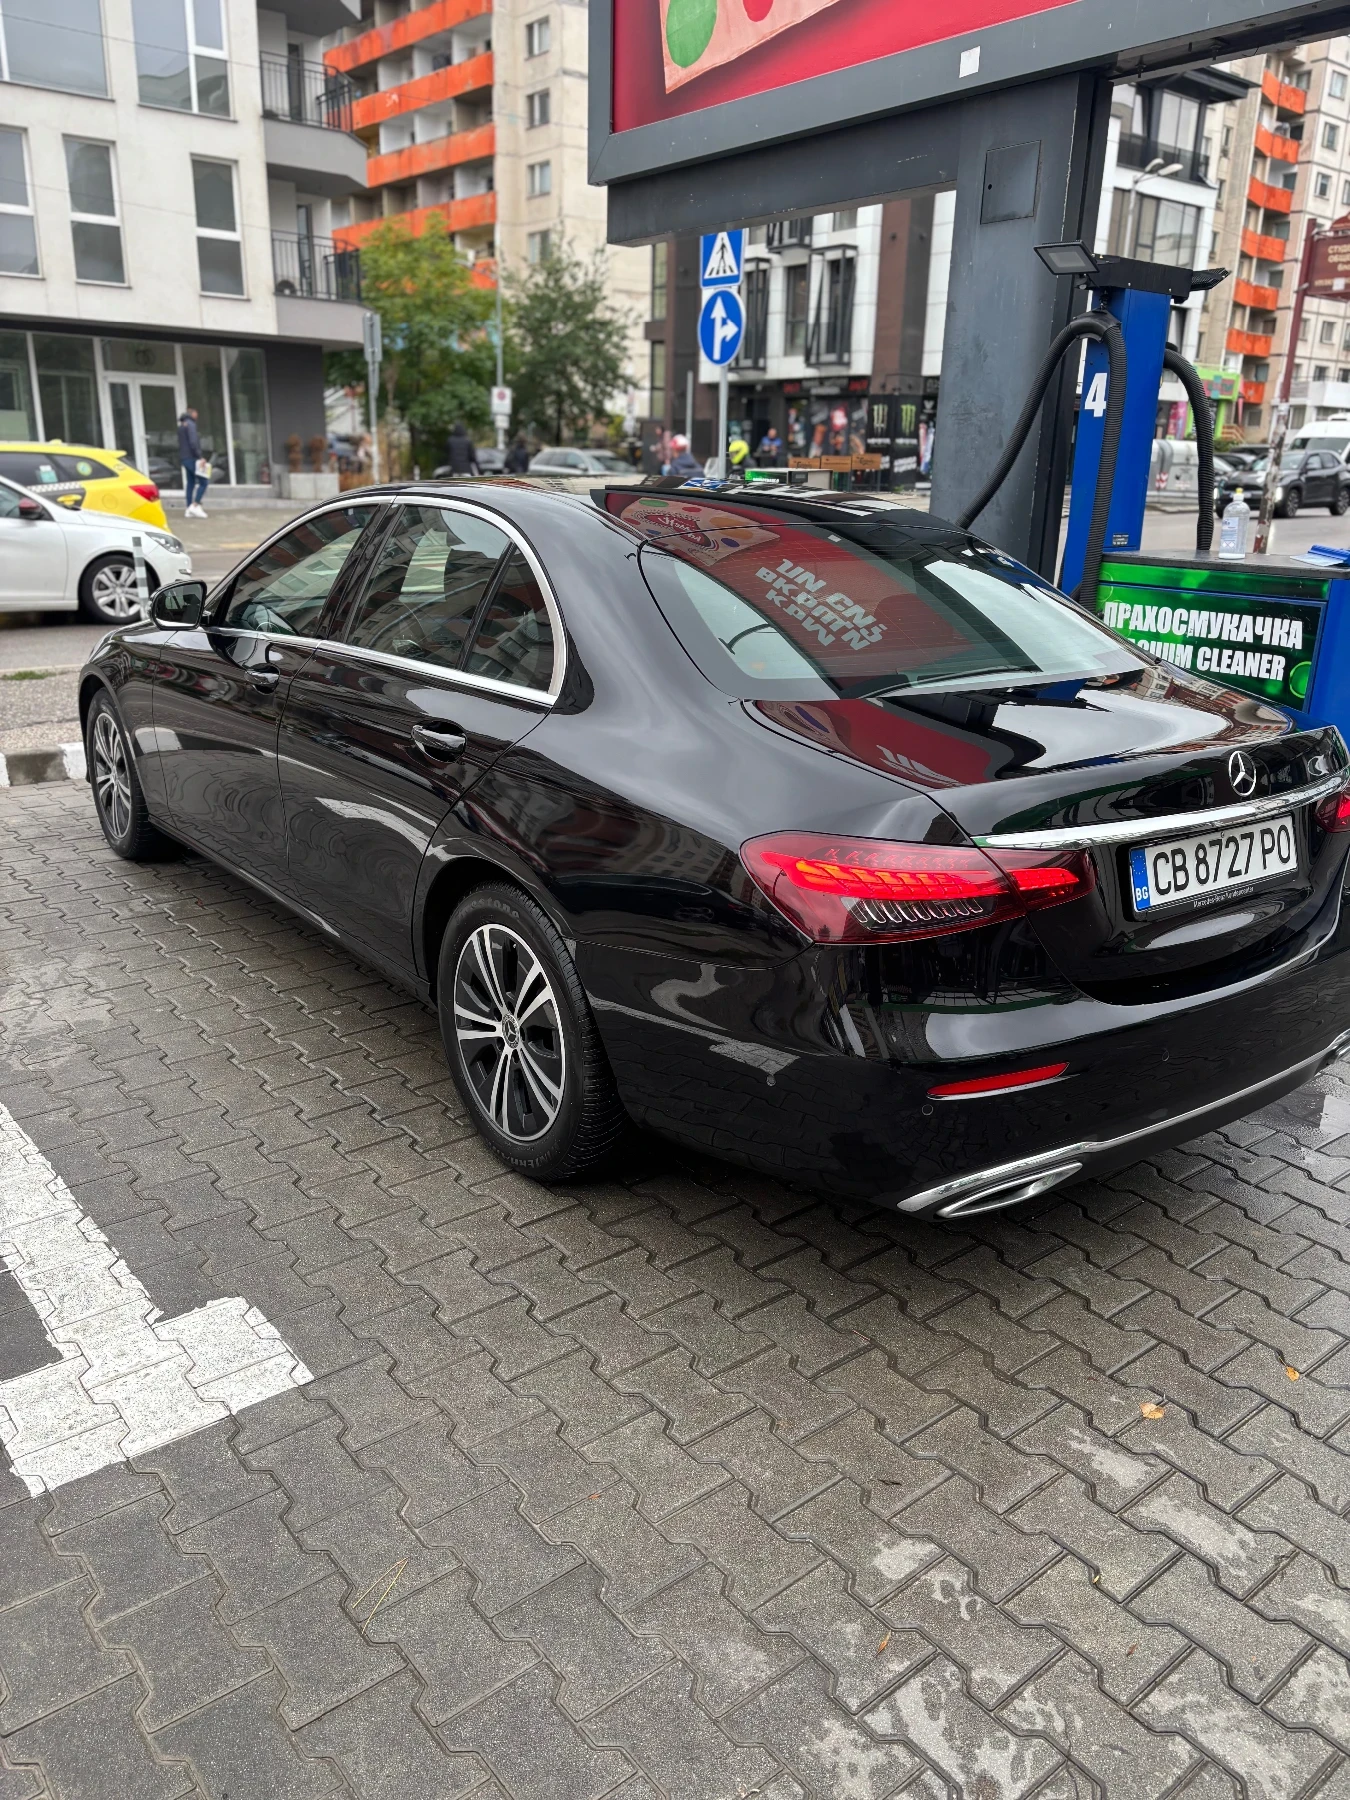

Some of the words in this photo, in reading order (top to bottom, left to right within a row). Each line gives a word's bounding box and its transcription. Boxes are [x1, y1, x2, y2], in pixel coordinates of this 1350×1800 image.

[1085, 373, 1108, 418] 4
[1103, 601, 1303, 649] ПРАХОСМУКАЧКА
[1128, 638, 1193, 669] CUUM
[1196, 646, 1286, 681] CLEANER
[1153, 848, 1190, 896] CB
[1194, 831, 1255, 885] 8727
[1260, 824, 1291, 870] PO
[1135, 886, 1149, 901] BG
